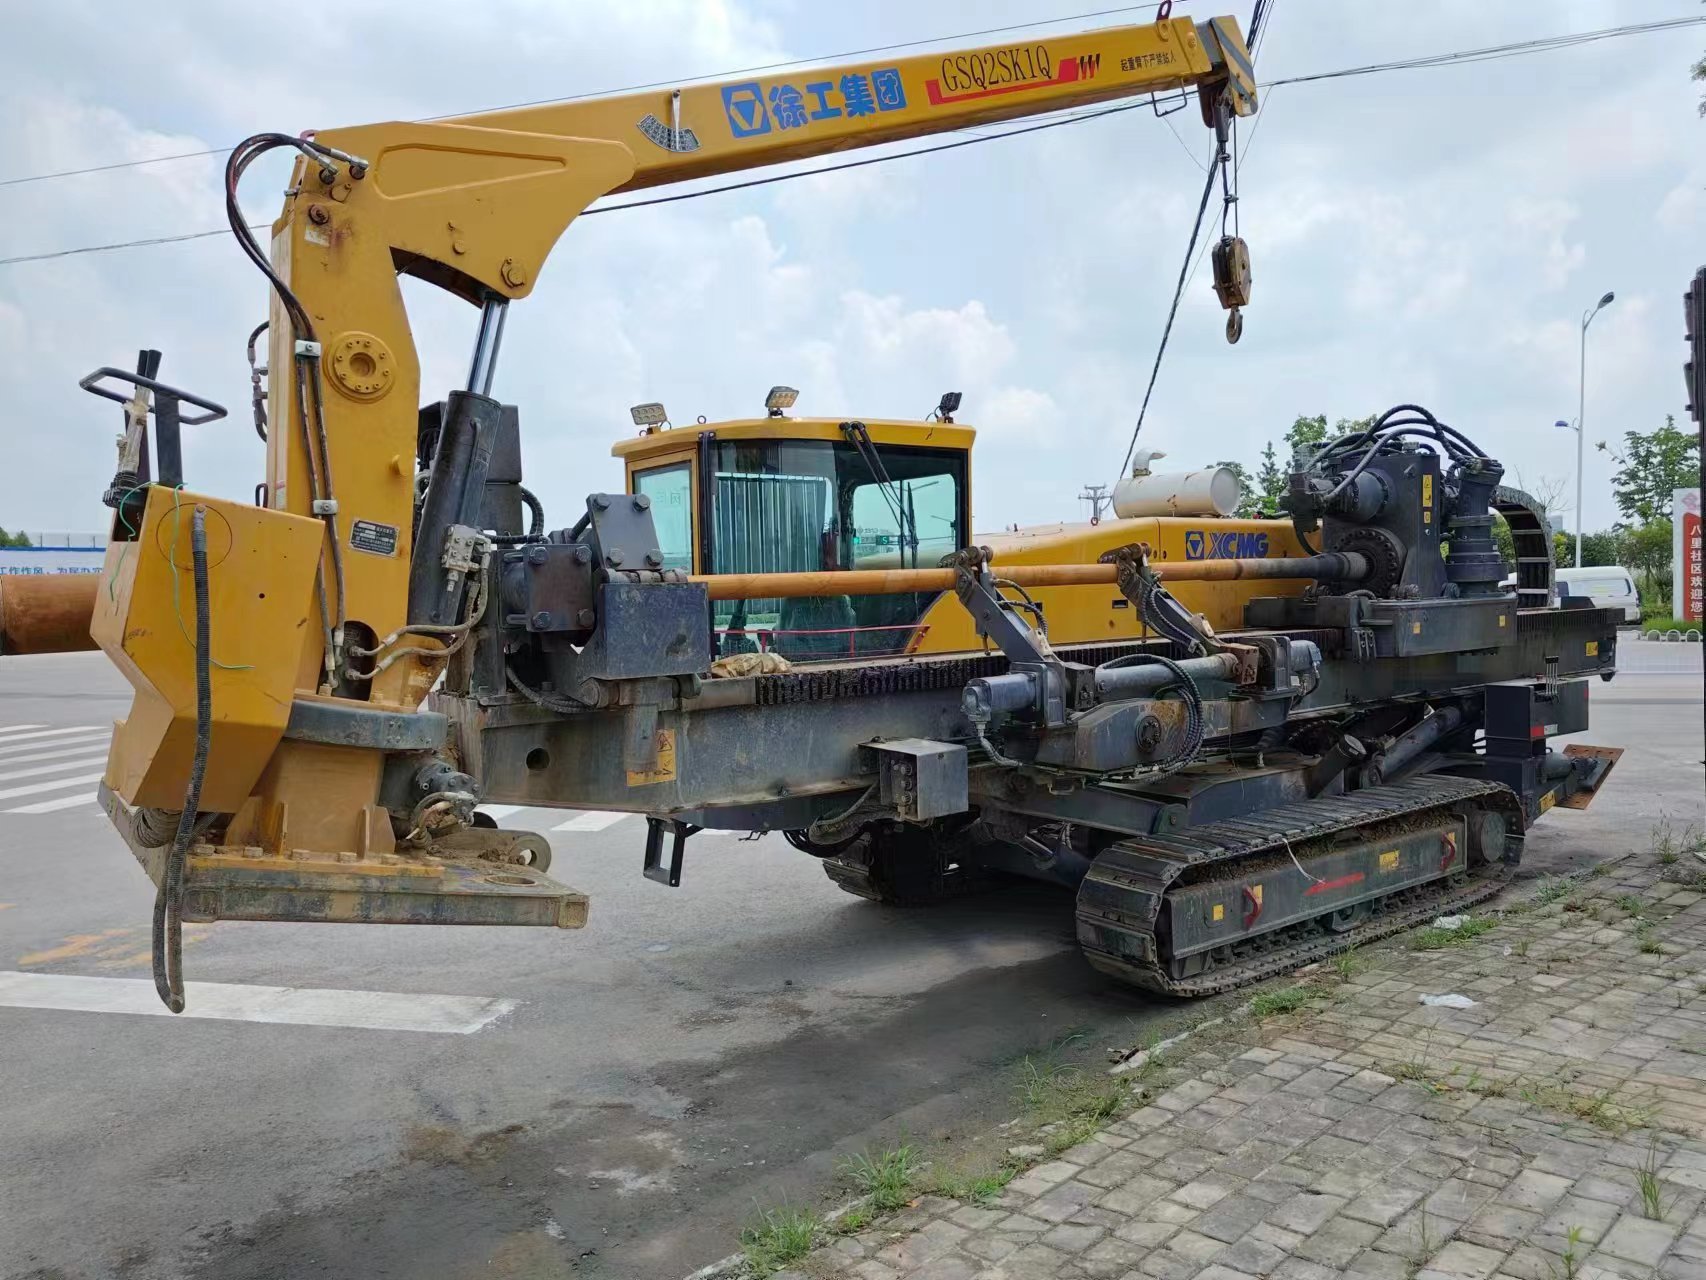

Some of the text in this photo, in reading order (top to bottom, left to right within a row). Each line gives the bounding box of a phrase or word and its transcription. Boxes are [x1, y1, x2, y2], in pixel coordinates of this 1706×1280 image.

[941, 45, 1052, 92] GSQ2SK1Q
[1120, 49, 1177, 72] 起重臂下严禁站人
[768, 67, 908, 131] 徐工集团
[1207, 531, 1270, 560] XCMG
[1690, 524, 1703, 622] 八里社区欢迎您
